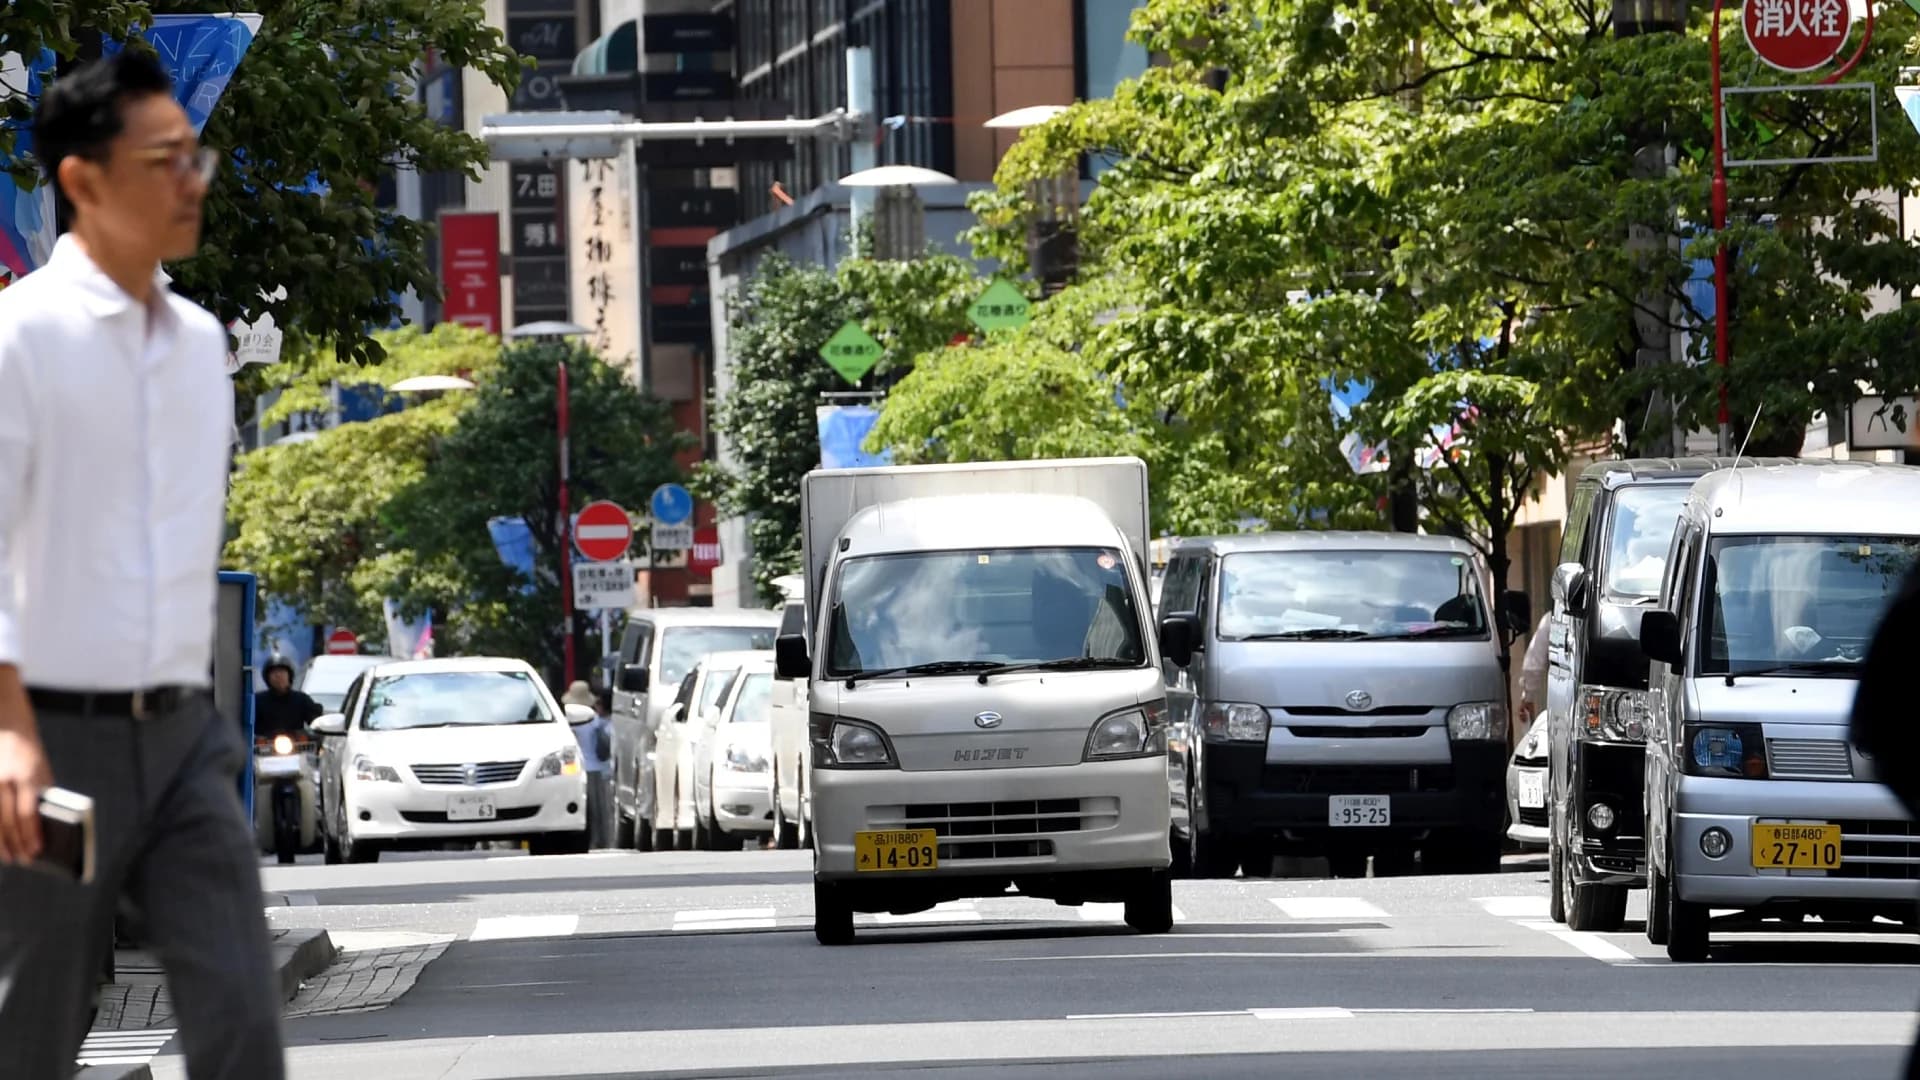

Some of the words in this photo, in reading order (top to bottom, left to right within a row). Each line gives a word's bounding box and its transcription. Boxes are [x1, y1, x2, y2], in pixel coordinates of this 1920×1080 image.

[1754, 0, 1842, 37] 消火栓
[953, 746, 1029, 762] HIJET
[1342, 807, 1388, 824] 95-25
[876, 846, 933, 869] 14-09
[1772, 842, 1836, 865] 27-10
